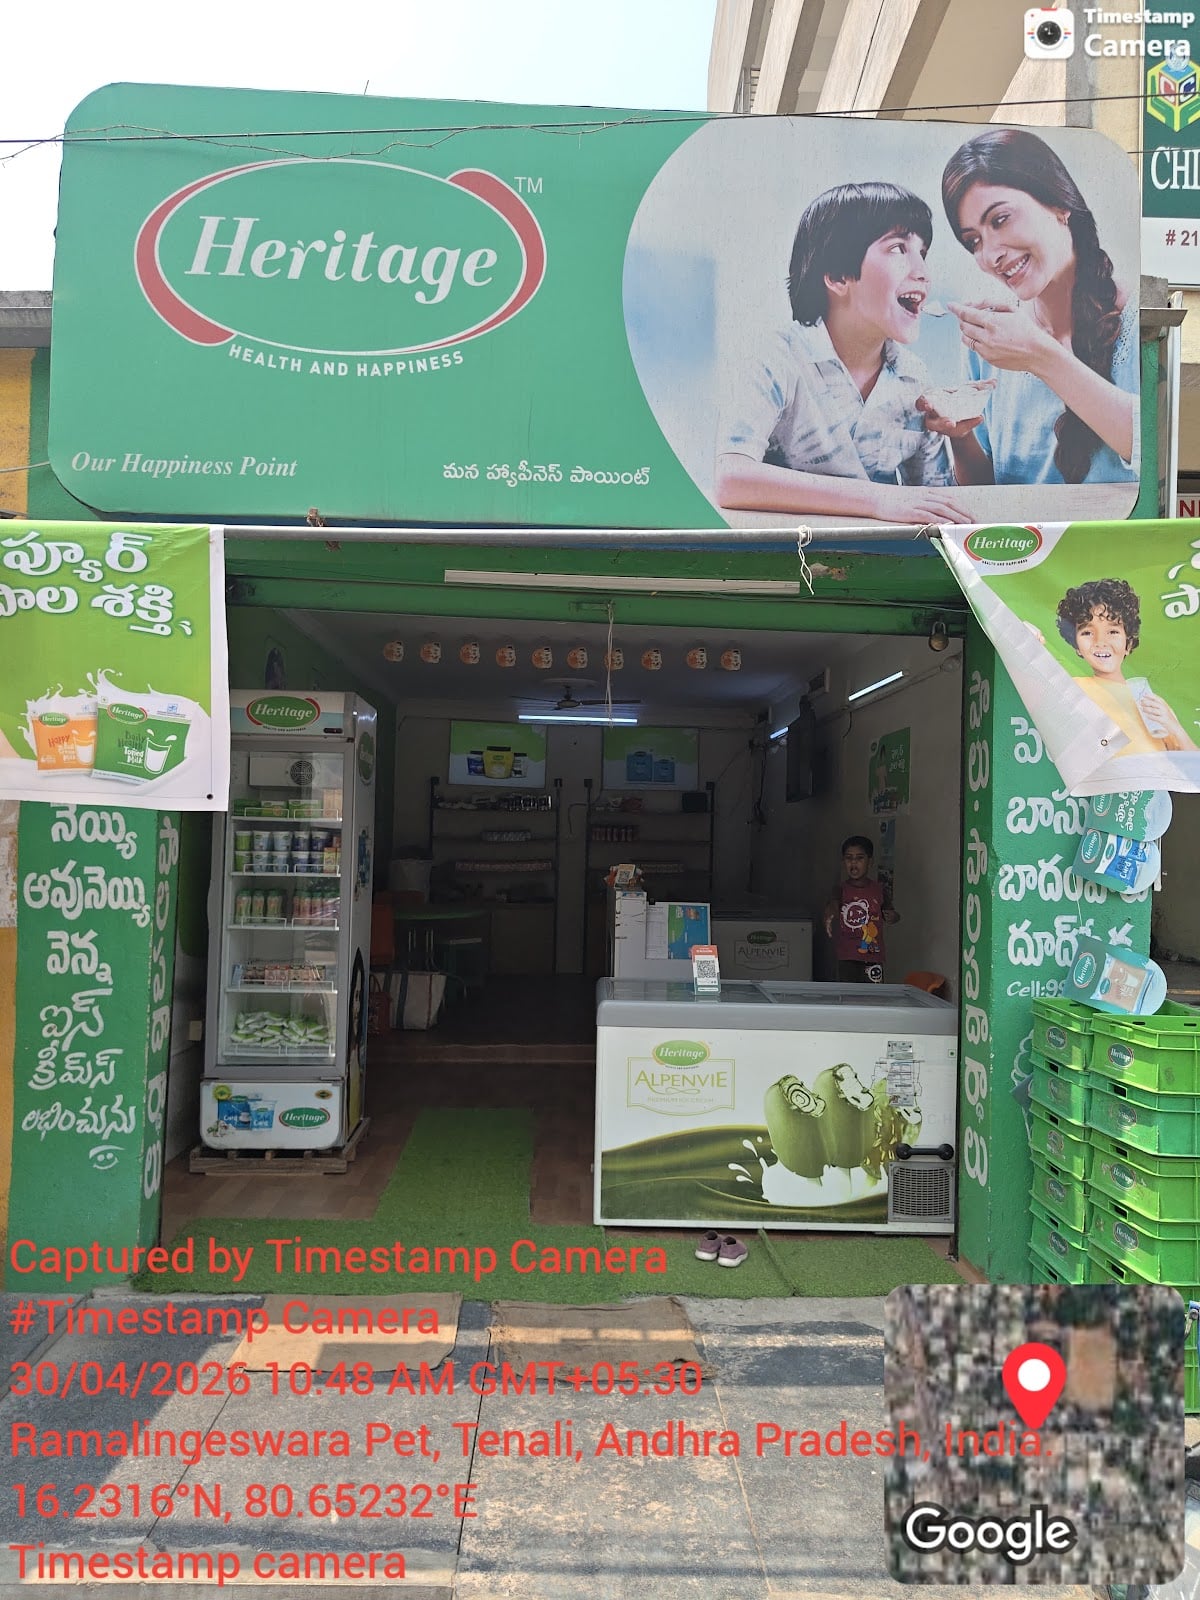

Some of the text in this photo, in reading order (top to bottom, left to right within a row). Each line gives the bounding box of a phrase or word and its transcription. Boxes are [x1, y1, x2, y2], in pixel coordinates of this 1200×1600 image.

[514, 176, 543, 194] TM
[184, 215, 499, 305] Heritage
[228, 343, 464, 377] HEALTH AND HAPPINESS
[71, 451, 299, 479] Our Happiness Point
[442, 461, 480, 480] మన
[569, 465, 651, 486] పాయింట్
[1179, 499, 1200, 518] N
[973, 536, 1034, 552] Heritage
[111, 706, 143, 720] Heritage
[255, 704, 313, 721] Heritage
[1084, 832, 1098, 860] Heritage
[1076, 956, 1093, 984] Heritage
[659, 1047, 705, 1060] Heritage
[1111, 1048, 1131, 1063] Heritage
[635, 1070, 729, 1089] ALPENVIE
[284, 1112, 326, 1123] Heritage
